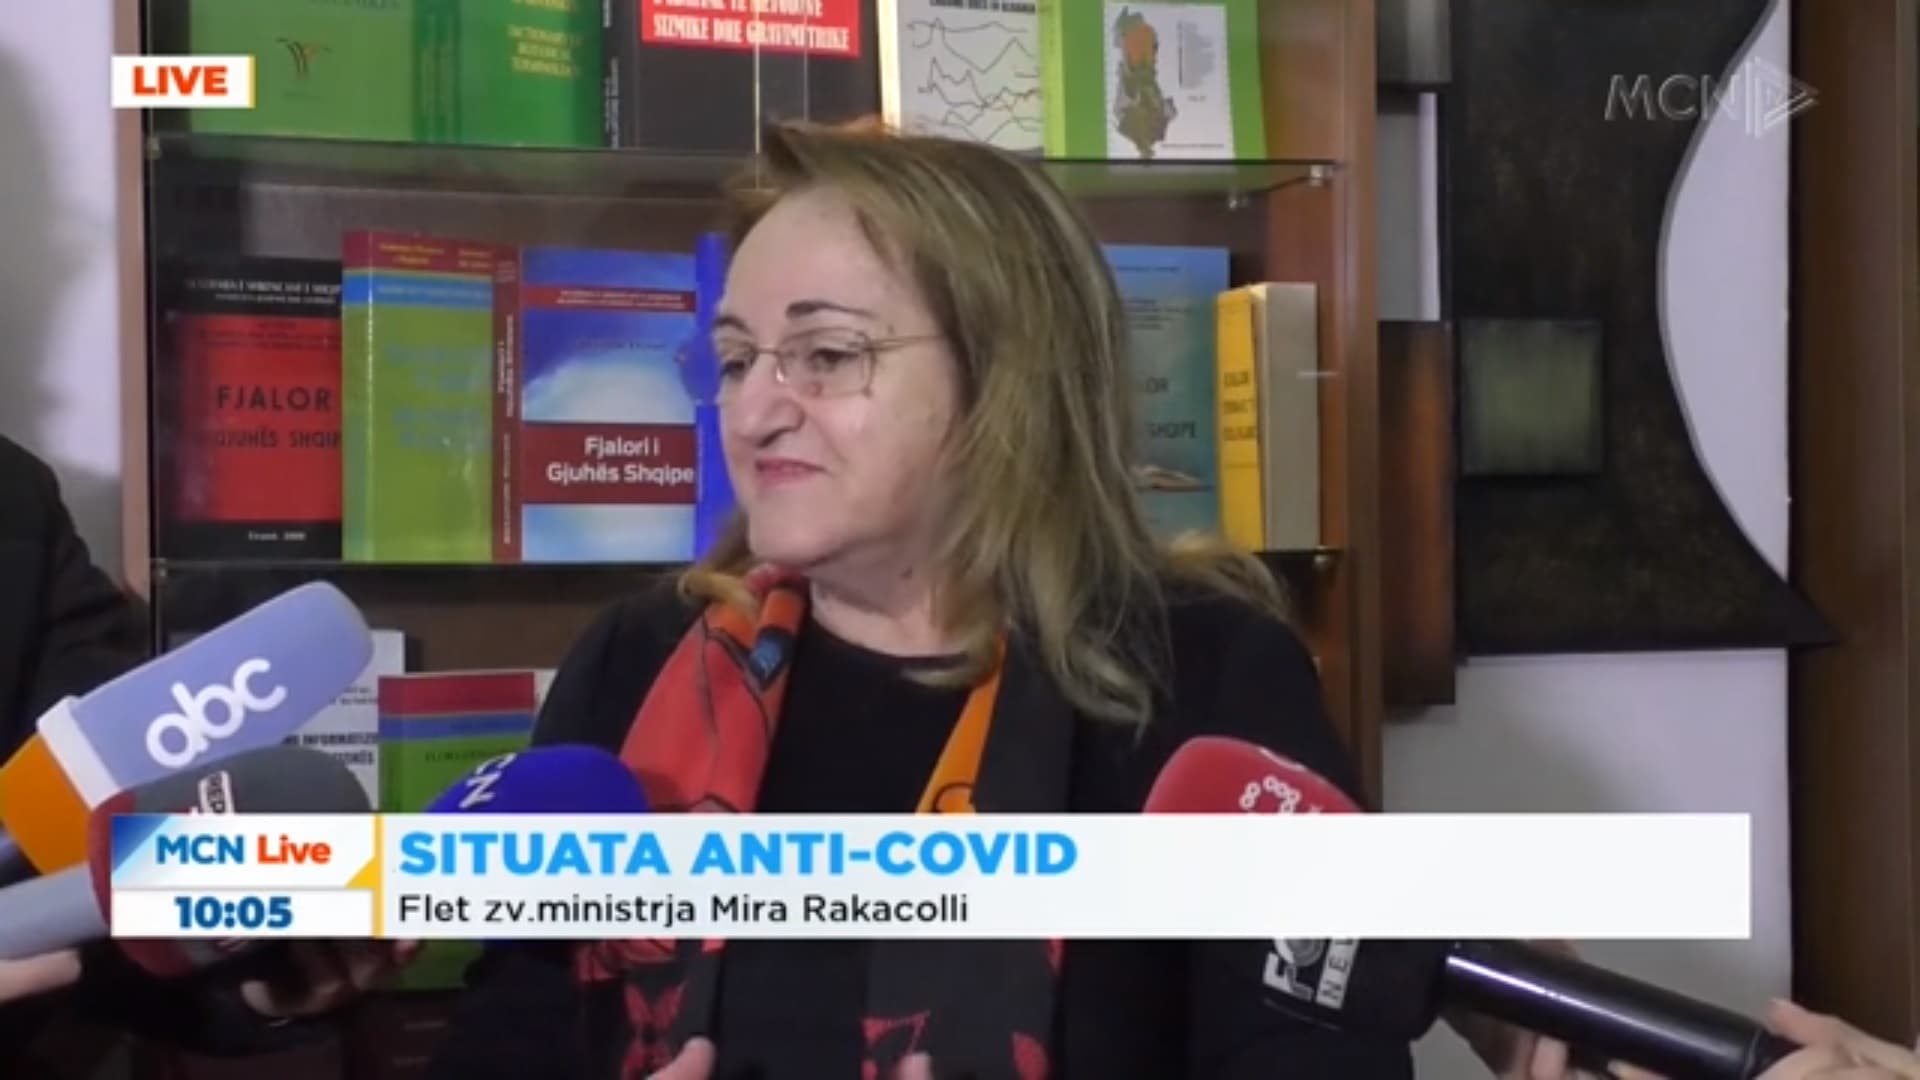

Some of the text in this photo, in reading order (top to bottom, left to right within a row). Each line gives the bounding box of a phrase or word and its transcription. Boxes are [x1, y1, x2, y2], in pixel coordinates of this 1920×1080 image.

[653, 13, 709, 40] SIZMIKE
[713, 18, 742, 43] DHE
[217, 384, 333, 412] FJALOR
[583, 436, 649, 459] Fjalori
[546, 462, 695, 487] Gjuhës Shqipe
[145, 657, 287, 768] abc
